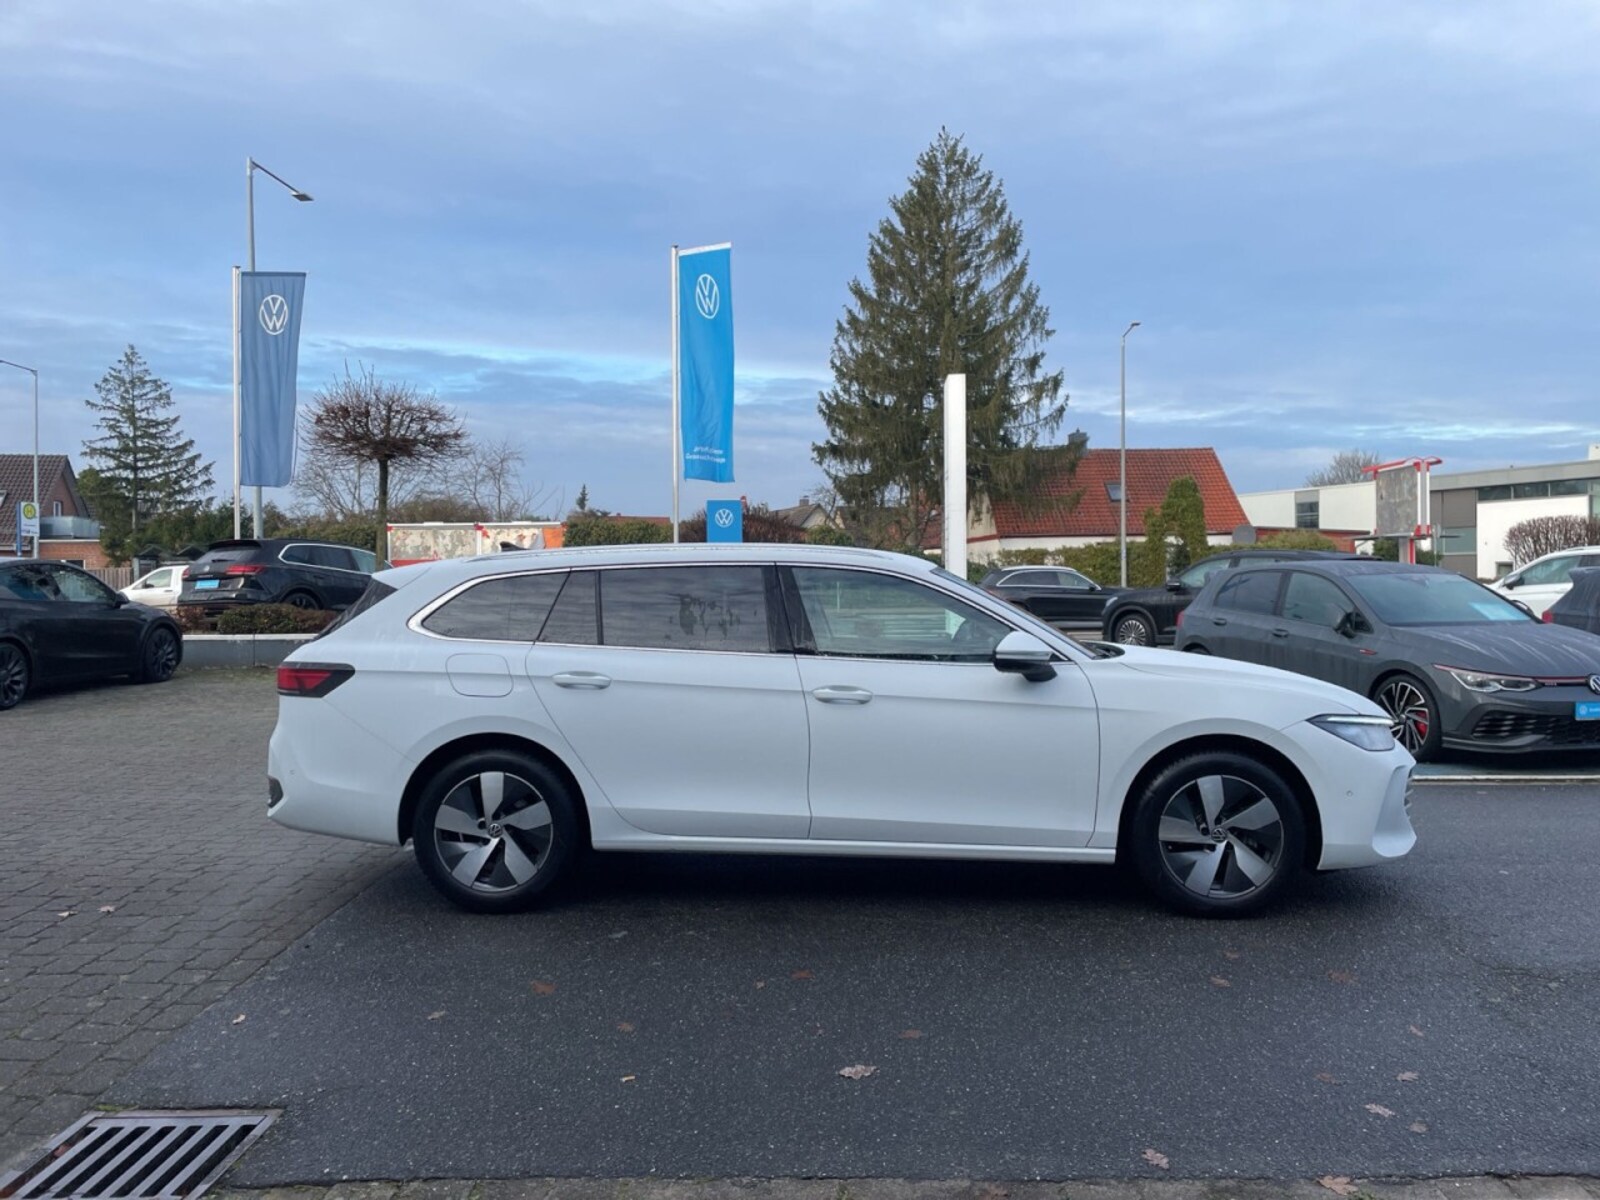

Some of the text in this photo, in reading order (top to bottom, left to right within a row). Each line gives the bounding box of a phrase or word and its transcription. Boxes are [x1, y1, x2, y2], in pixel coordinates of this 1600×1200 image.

[259, 294, 289, 336] VW
[695, 273, 720, 319] VW
[715, 508, 734, 528] VW
